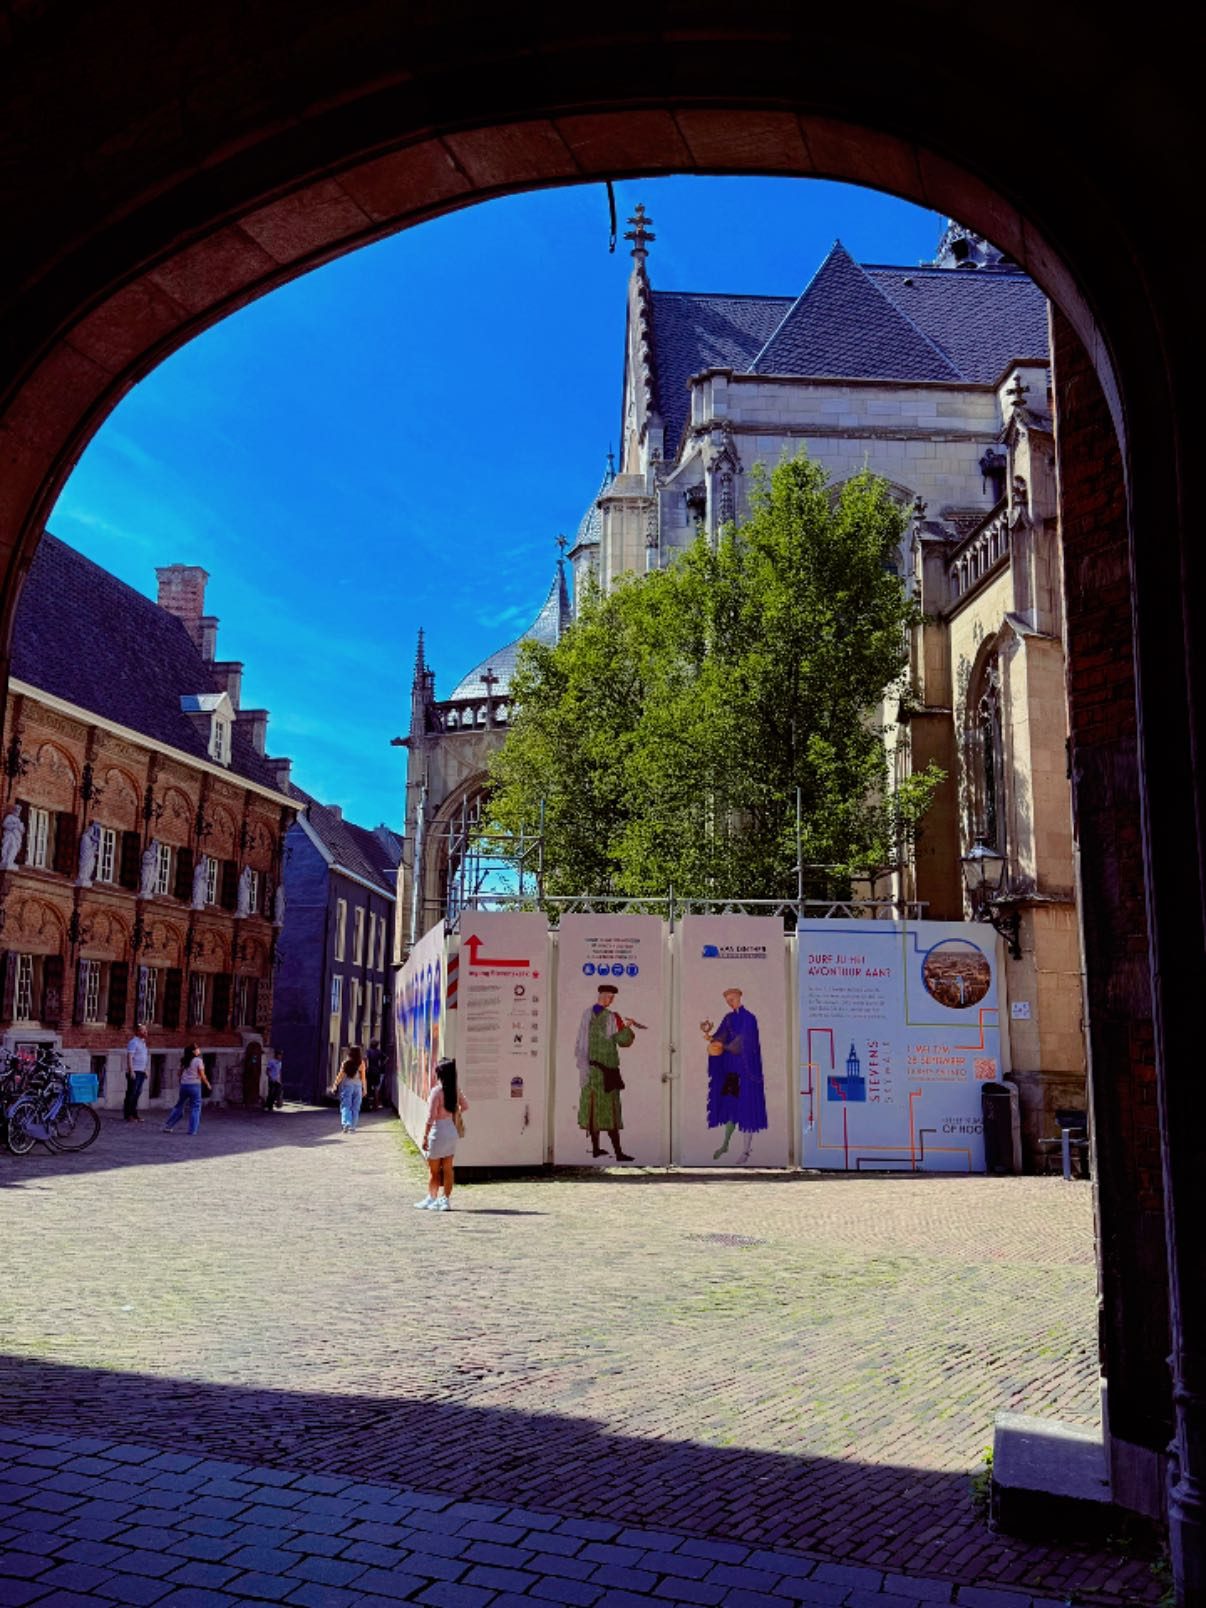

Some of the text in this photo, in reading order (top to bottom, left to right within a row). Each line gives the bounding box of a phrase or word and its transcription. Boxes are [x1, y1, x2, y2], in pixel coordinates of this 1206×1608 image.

[808, 954, 833, 964] DURF
[808, 966, 891, 978] AVONTUUR AAN?
[920, 1056, 966, 1066] SEPTEMBER
[867, 1040, 880, 1103] STEVENS
[942, 1124, 957, 1134] OP
